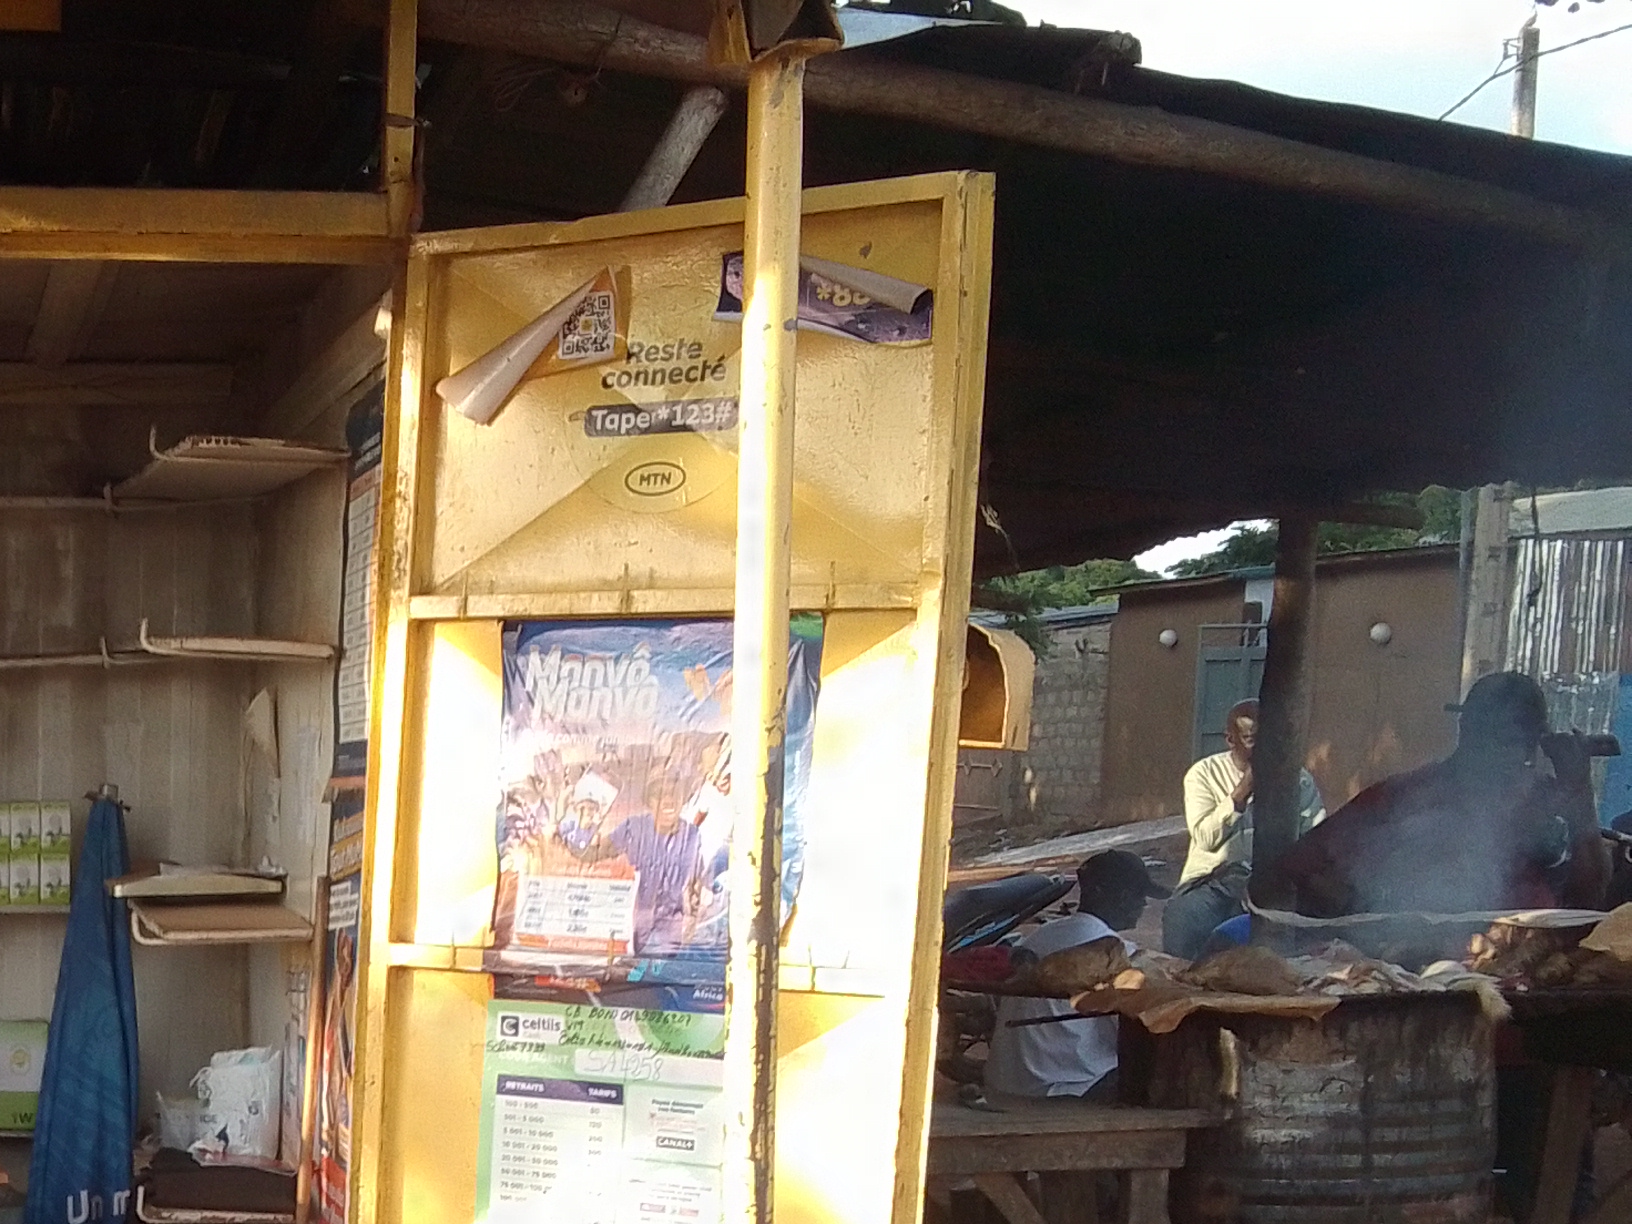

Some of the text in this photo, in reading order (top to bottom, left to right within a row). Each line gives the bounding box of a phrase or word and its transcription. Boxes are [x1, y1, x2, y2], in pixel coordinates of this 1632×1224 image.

[625, 338, 703, 365] Reste
[601, 354, 727, 389] connecté
[639, 471, 672, 486] MTN
[588, 1087, 618, 1098] TARIFS
